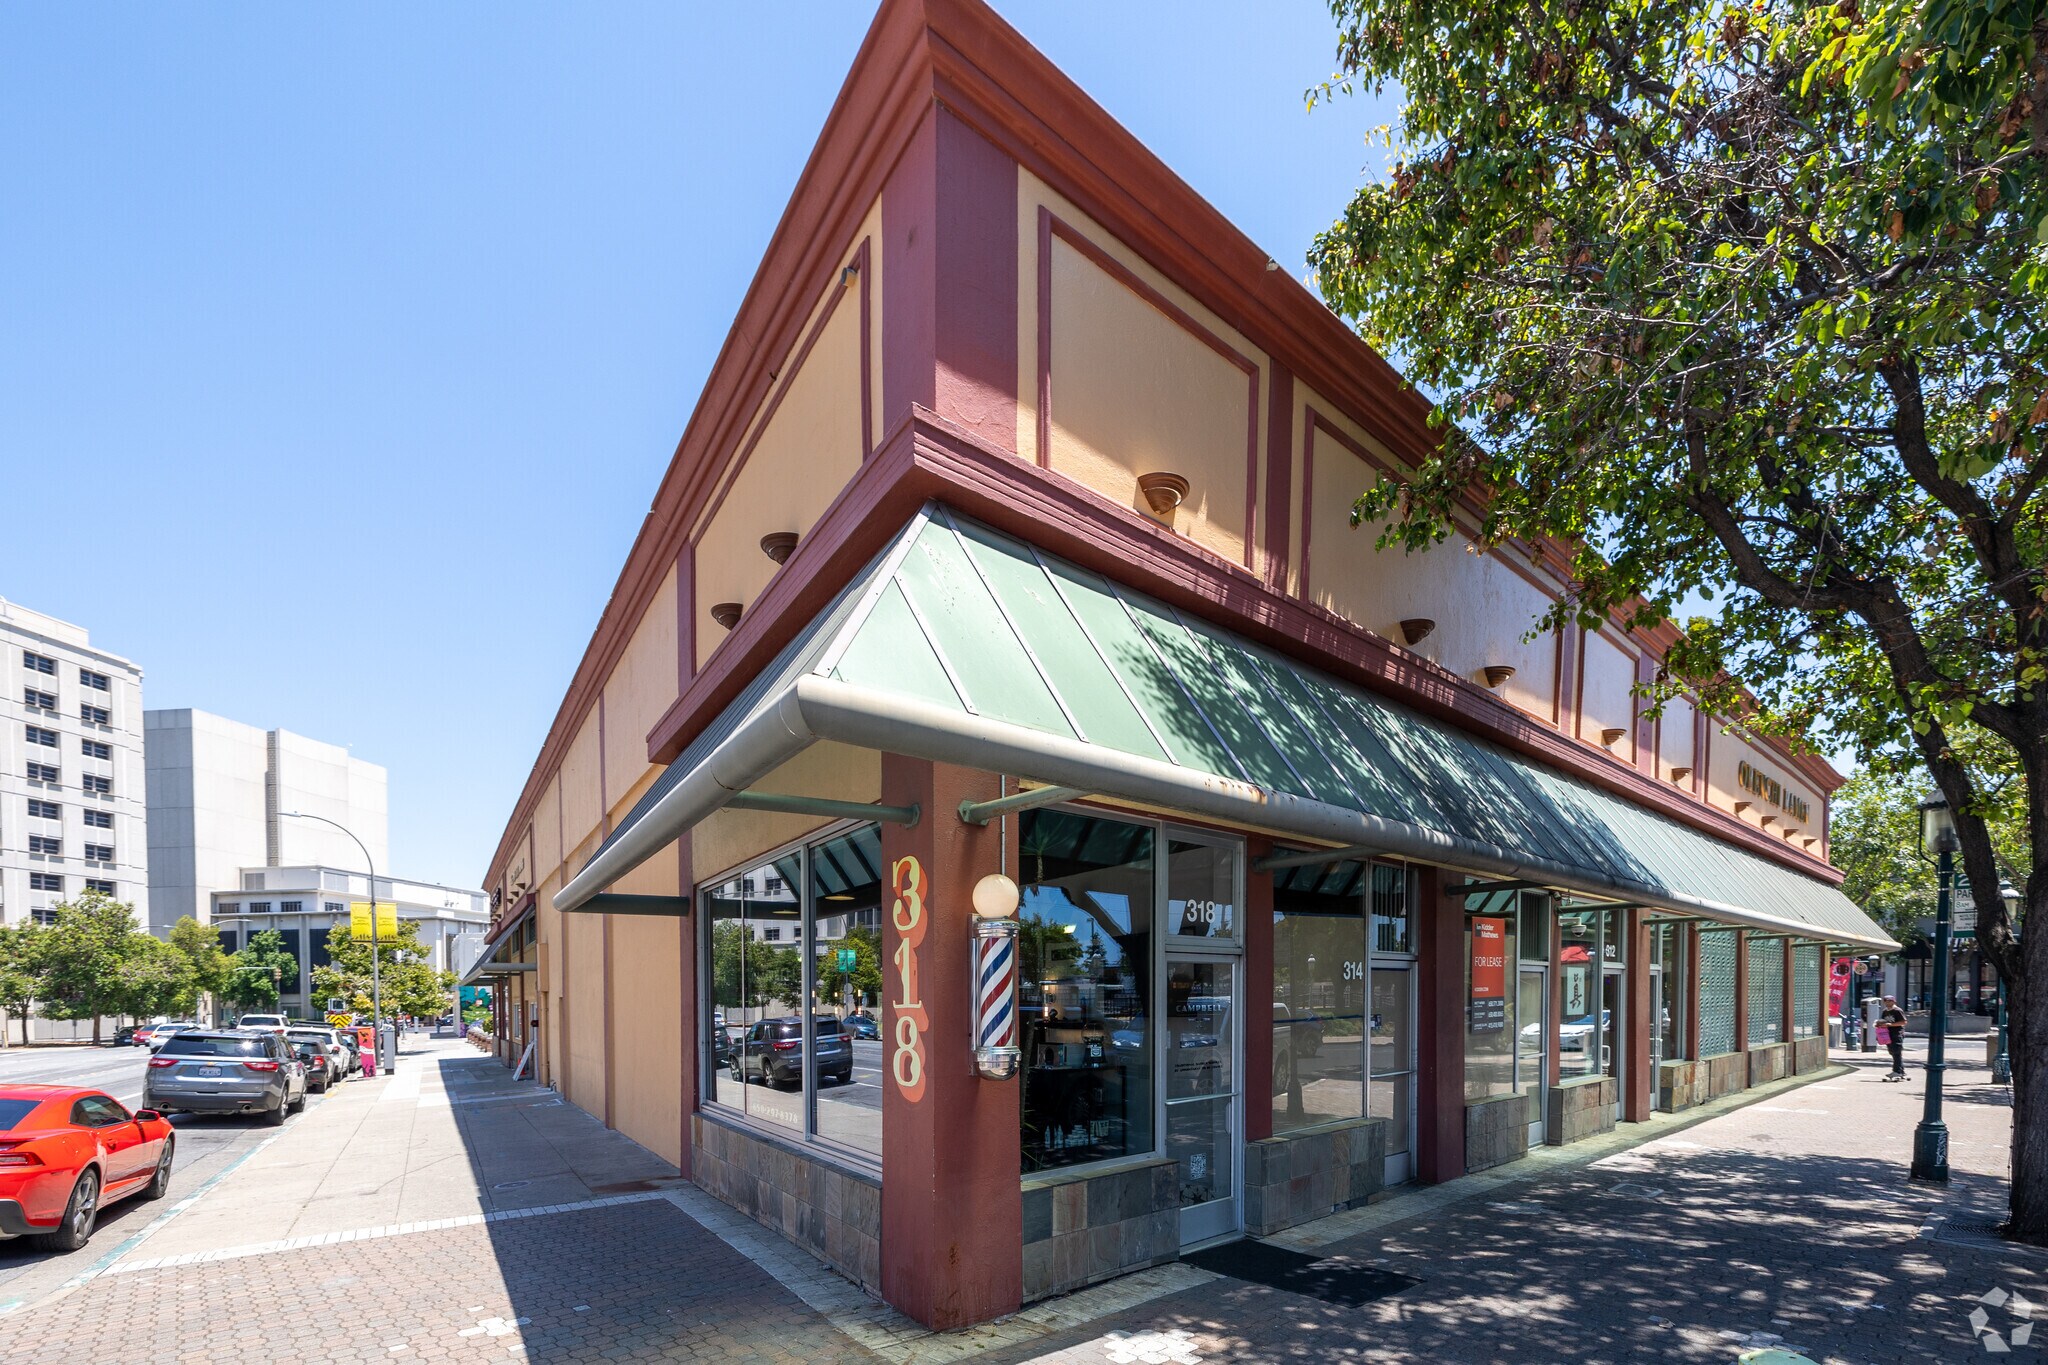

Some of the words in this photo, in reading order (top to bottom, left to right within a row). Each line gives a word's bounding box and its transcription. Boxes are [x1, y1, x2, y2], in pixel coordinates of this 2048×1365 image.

[1186, 899, 1216, 924] 318
[1343, 961, 1363, 980] 314
[1474, 956, 1486, 967] FOR
[1486, 956, 1502, 967] LEASE
[892, 855, 926, 1095] 318
[1176, 1004, 1222, 1013] CAMPBELL
